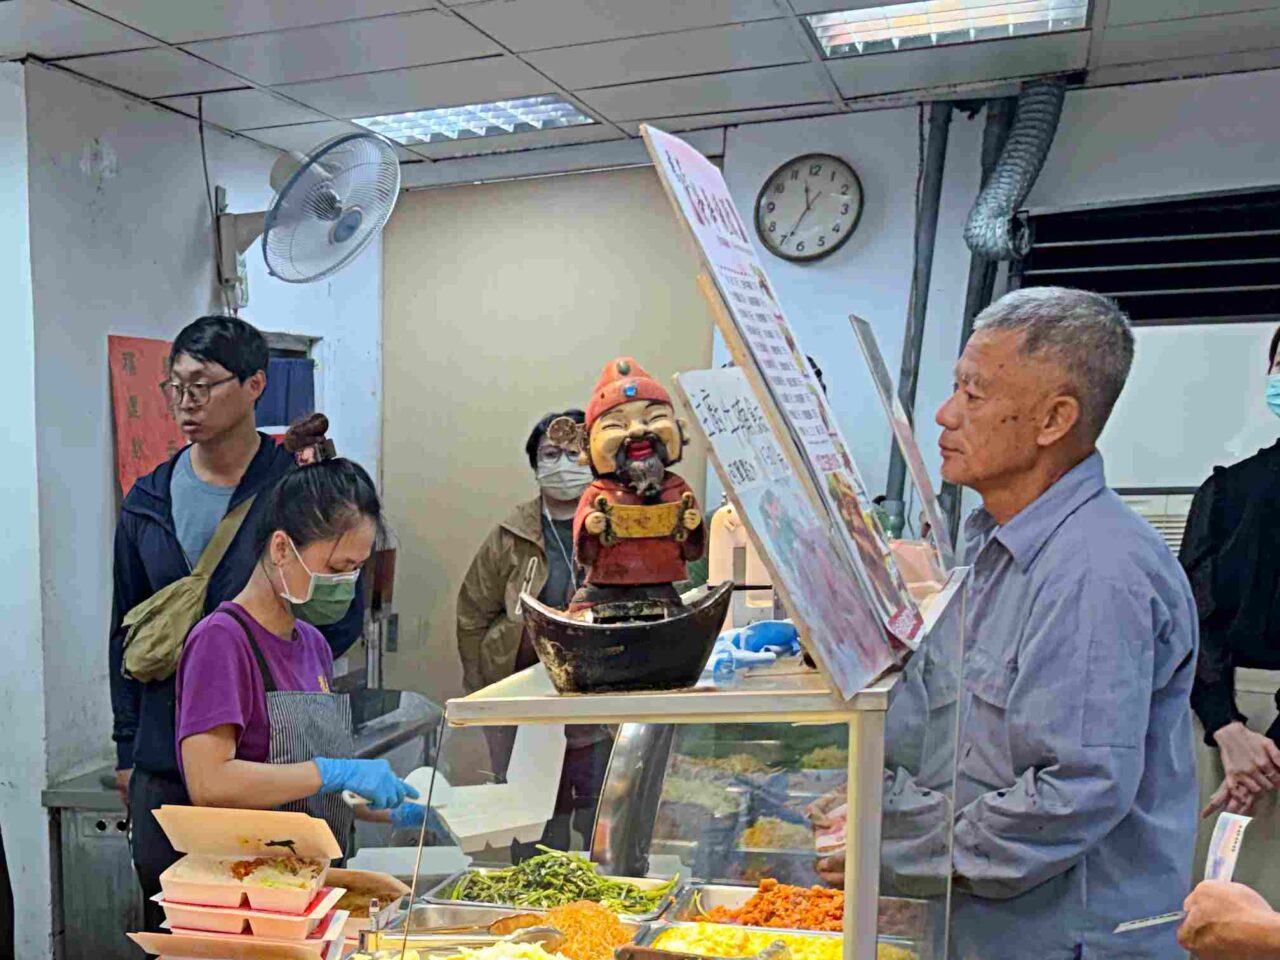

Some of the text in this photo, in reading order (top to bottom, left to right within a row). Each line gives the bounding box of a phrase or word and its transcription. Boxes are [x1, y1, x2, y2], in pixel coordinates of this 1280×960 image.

[790, 170, 799, 181] 11
[809, 164, 822, 177] 12
[830, 170, 836, 182] 1
[774, 183, 784, 194] 10
[841, 184, 849, 195] 2
[766, 201, 775, 213] 9
[840, 203, 849, 215] 3
[768, 222, 776, 233] 8
[832, 222, 840, 233] 4
[780, 235, 787, 246] 7
[817, 236, 825, 247] 5
[796, 241, 805, 252] 6
